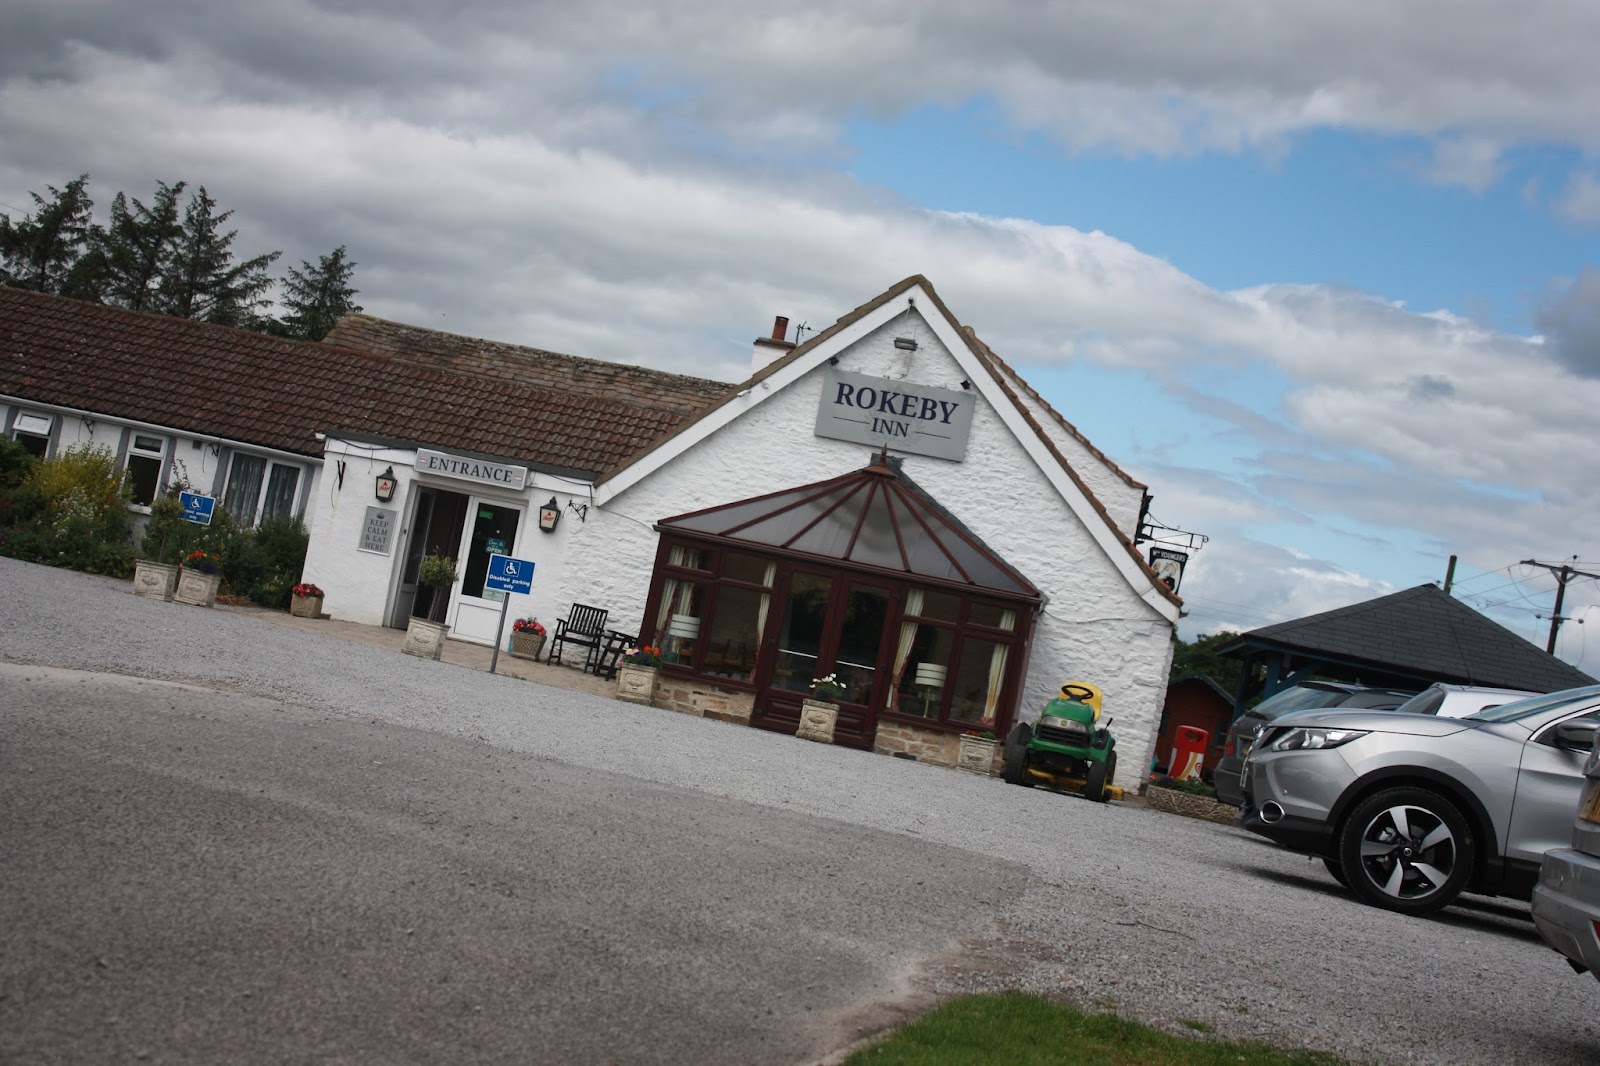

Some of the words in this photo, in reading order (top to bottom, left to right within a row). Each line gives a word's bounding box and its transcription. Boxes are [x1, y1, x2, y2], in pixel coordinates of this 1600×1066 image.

[834, 382, 959, 425] ROKEBY
[870, 417, 910, 438] INN
[428, 456, 513, 483] ENTRANCE
[370, 518, 389, 528] KEEP
[367, 526, 388, 536] CALM
[372, 535, 387, 544] EAT
[365, 541, 384, 552] HERE
[486, 546, 503, 554] OPEN
[489, 574, 511, 583] Disabled
[512, 579, 531, 588] parking
